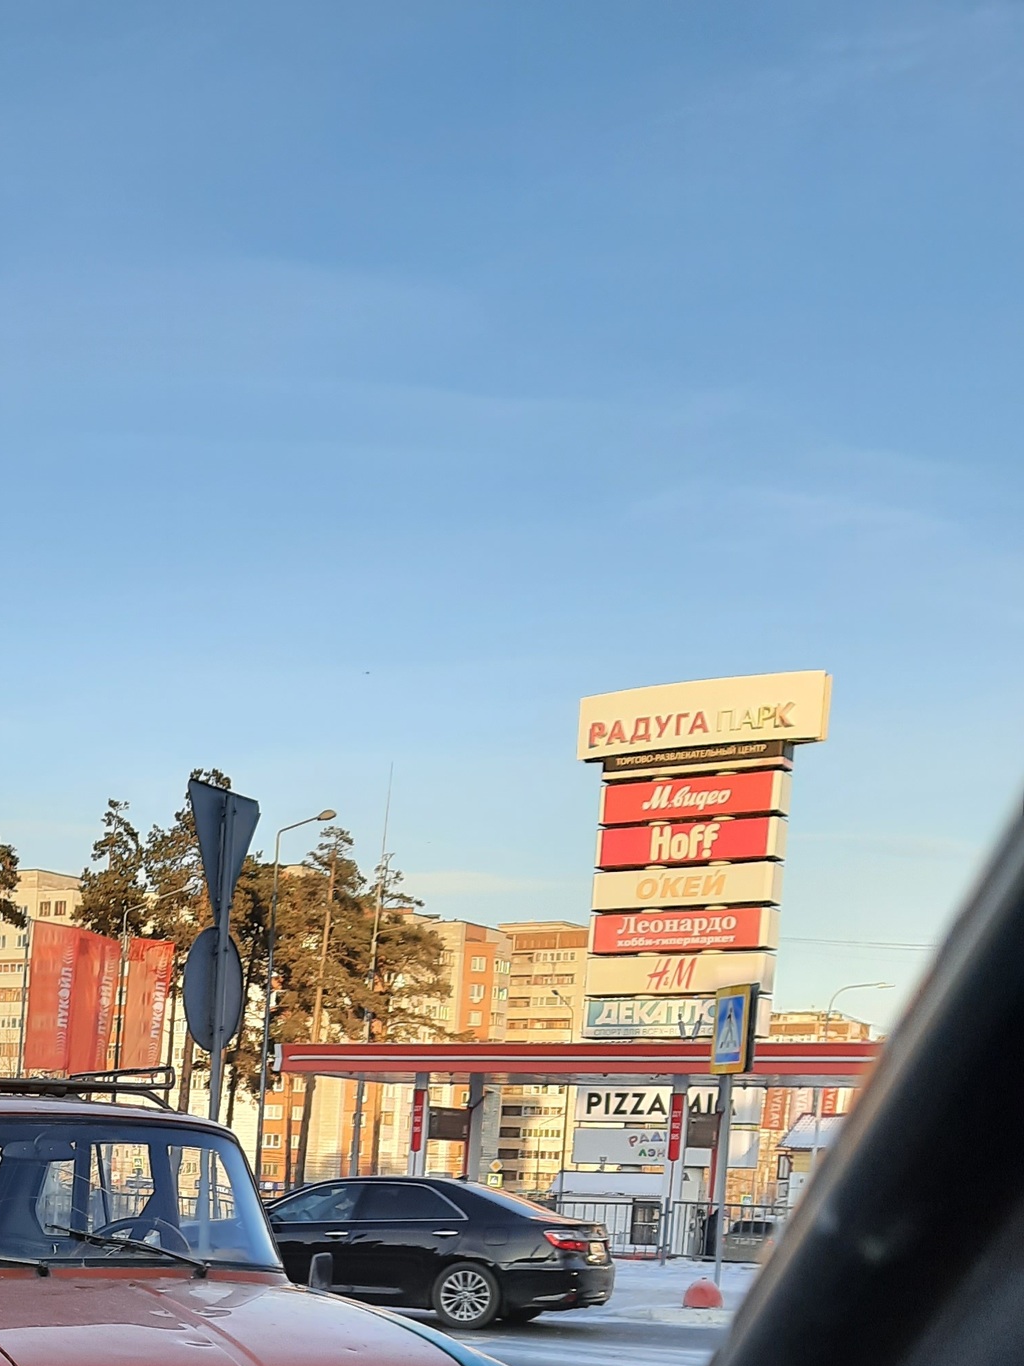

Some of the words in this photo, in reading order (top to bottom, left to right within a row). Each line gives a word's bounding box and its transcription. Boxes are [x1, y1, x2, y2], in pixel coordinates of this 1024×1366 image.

[588, 711, 709, 748] РАДУГА
[716, 702, 796, 732] ПАРК
[615, 746, 736, 767] ТОРГОВО-РАЗВЛЕКАТЕЛЬНЫЙ
[738, 743, 767, 754] ЦЕНТР
[617, 916, 737, 936] Леонардо
[617, 935, 736, 948] хобби-гипермаркет
[646, 957, 697, 990] H&M
[586, 1092, 667, 1115] PIZZA
